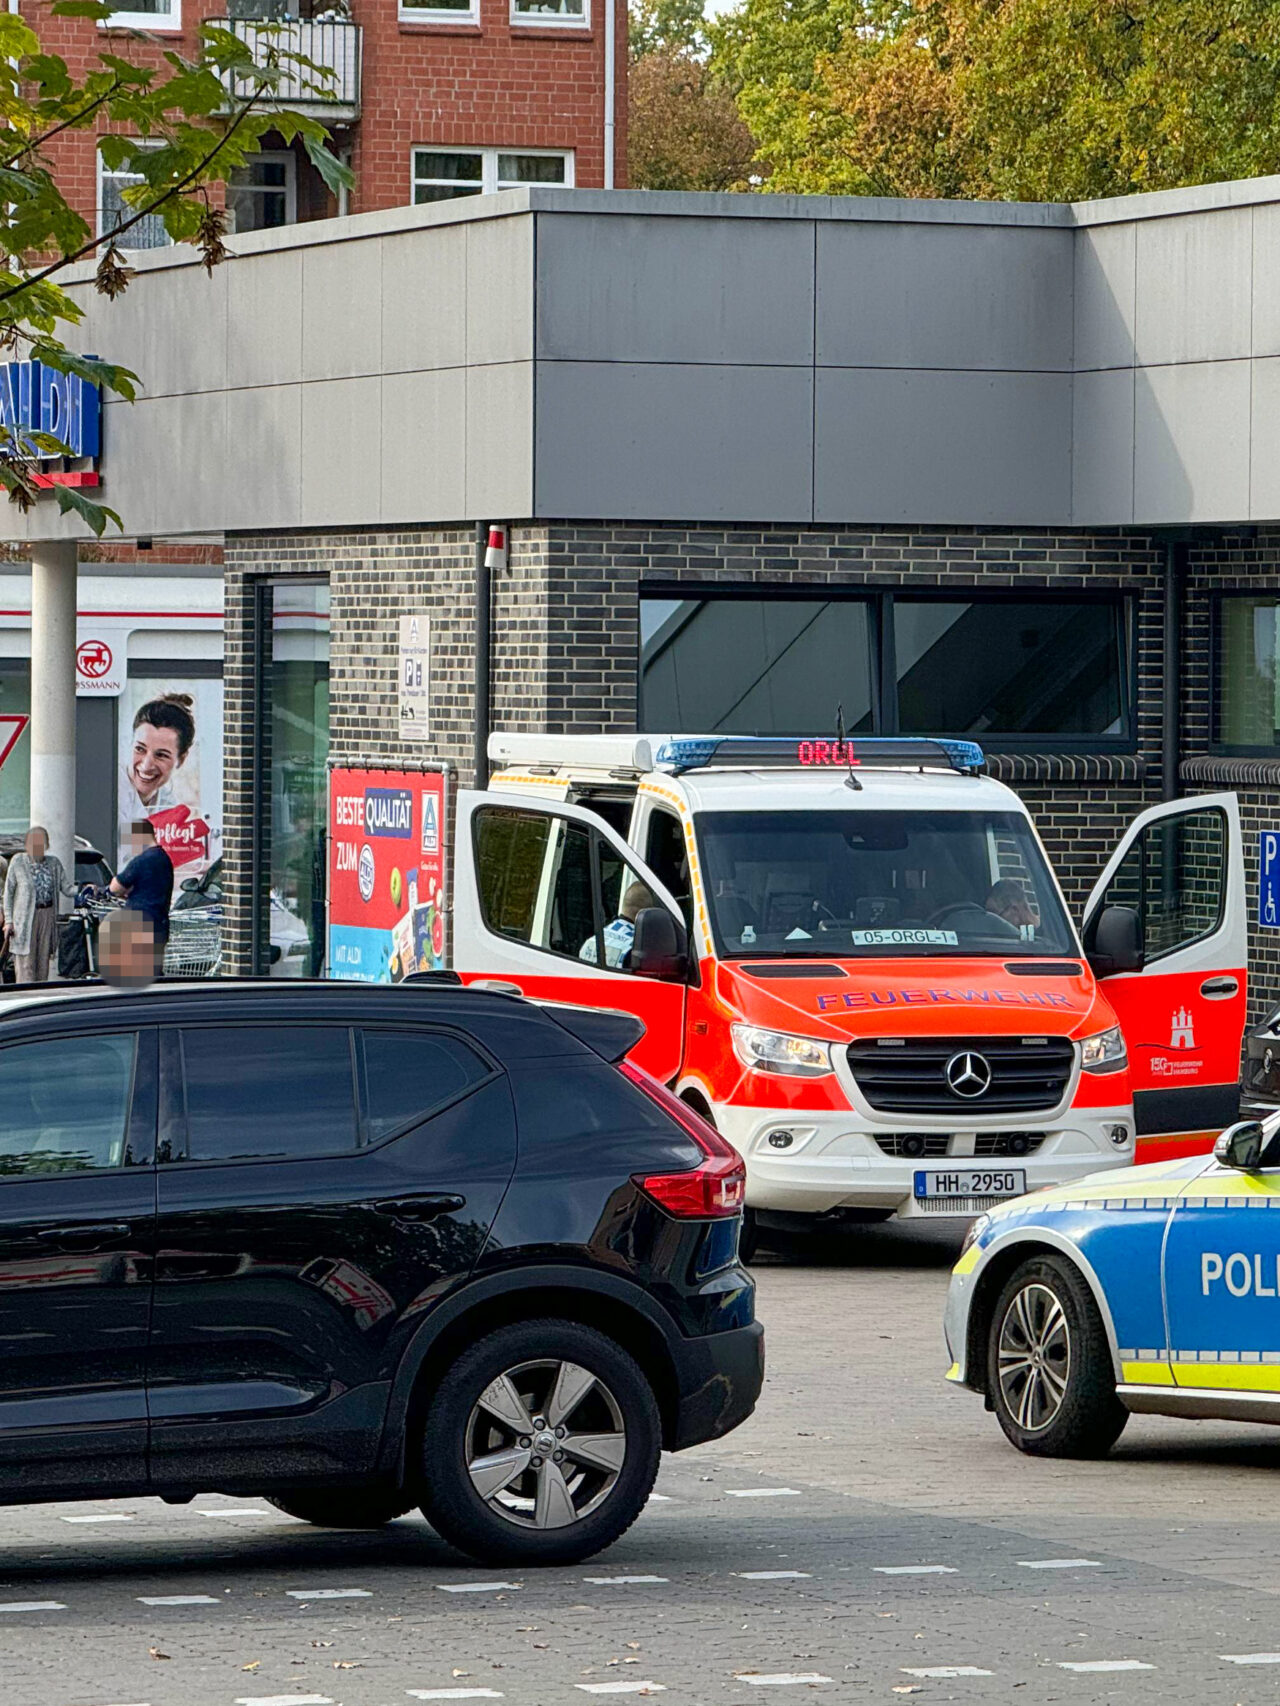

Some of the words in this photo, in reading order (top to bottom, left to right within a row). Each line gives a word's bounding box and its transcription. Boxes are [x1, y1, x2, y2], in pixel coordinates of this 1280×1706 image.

[799, 741, 861, 765] ORGL
[336, 796, 364, 826] BESTE
[365, 792, 412, 834] QUALITÄT
[153, 822, 196, 844] pflegt
[336, 841, 358, 871] ZUM
[1265, 835, 1277, 876] P
[863, 931, 949, 944] 05-ORGL-1
[347, 946, 362, 965] ALDI
[817, 989, 1075, 1010] FEUERWEHR
[935, 1174, 959, 1193] HH
[971, 1173, 1015, 1192] 2950
